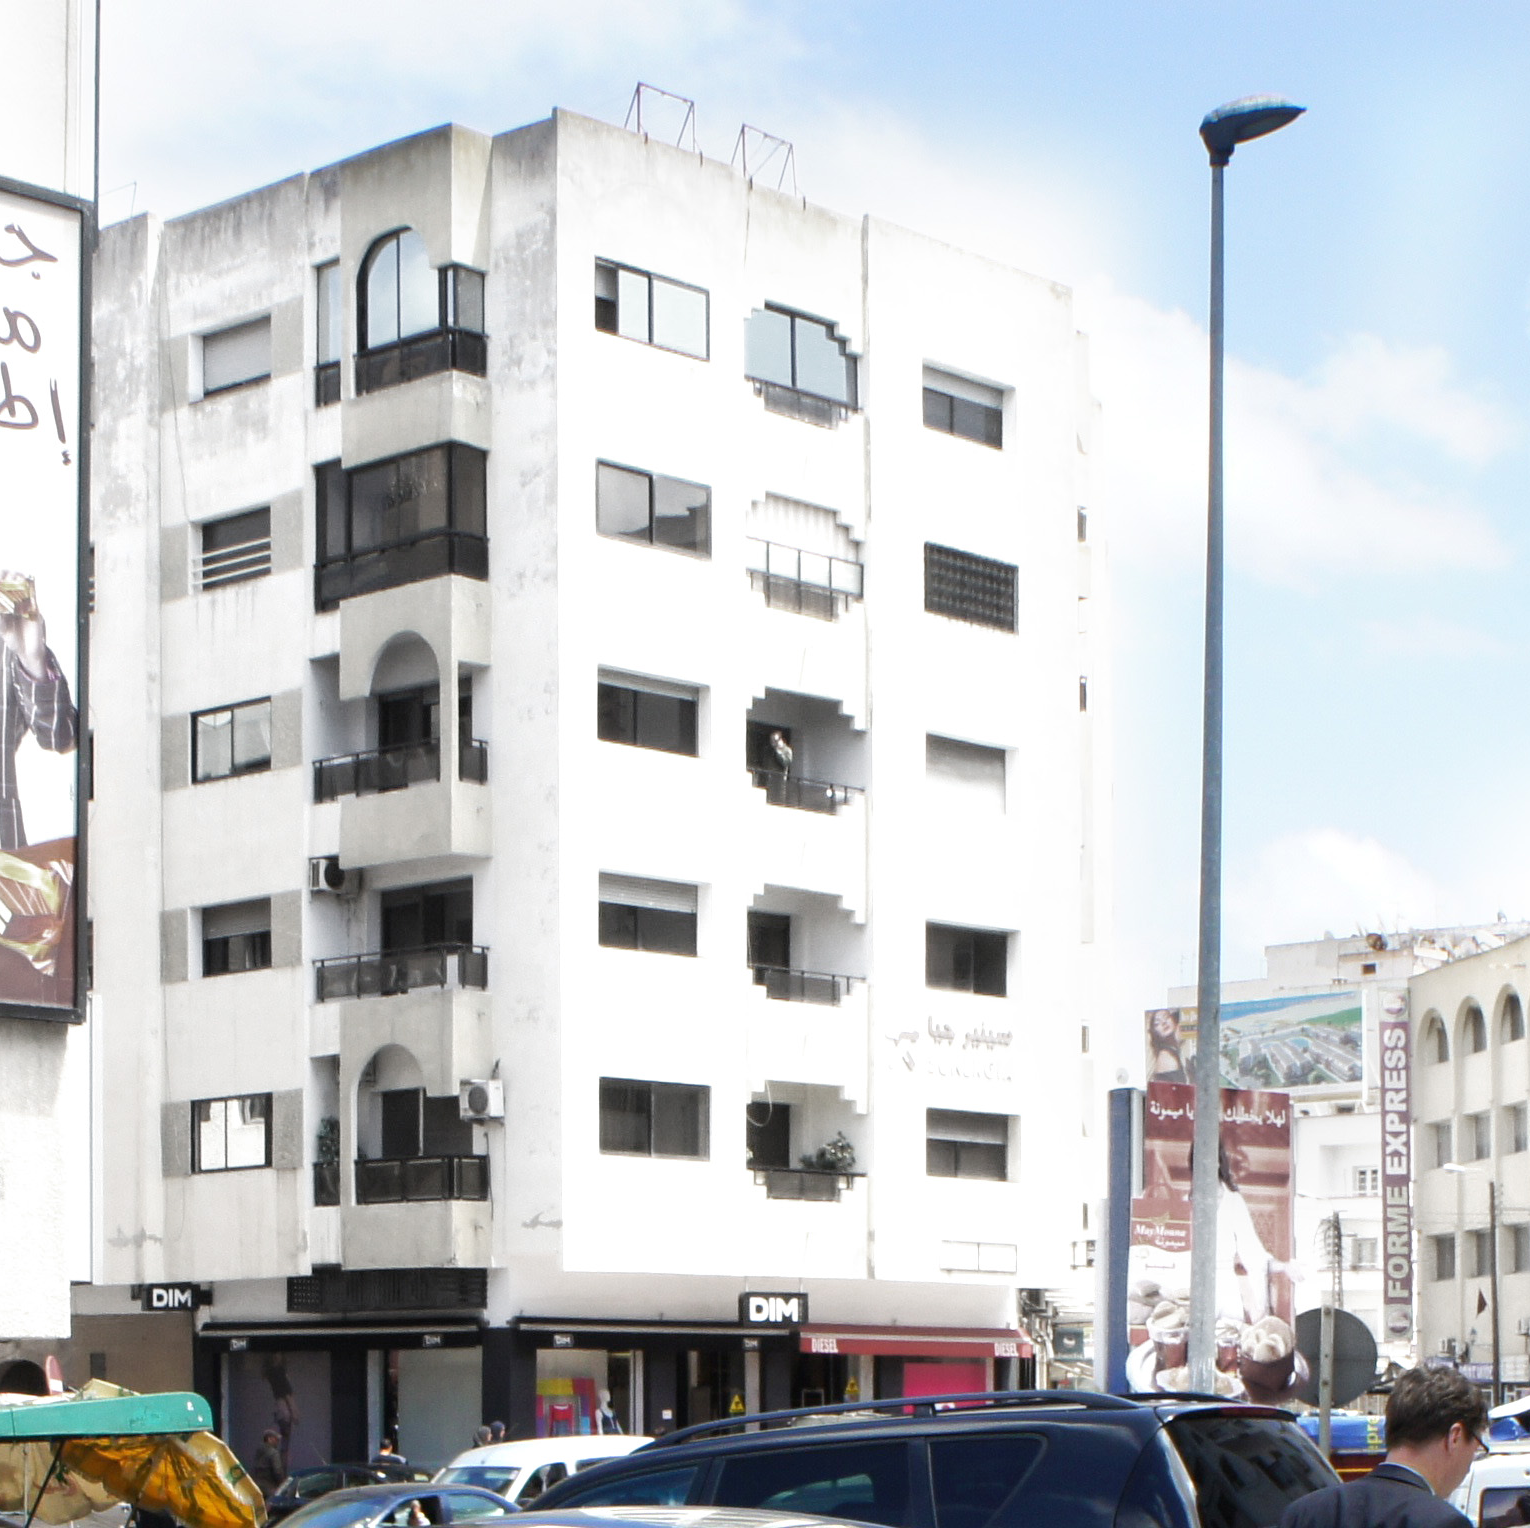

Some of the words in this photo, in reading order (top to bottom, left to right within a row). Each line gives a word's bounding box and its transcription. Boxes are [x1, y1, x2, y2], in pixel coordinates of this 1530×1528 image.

[1383, 1027, 1408, 1176] EXPRESS
[1387, 1185, 1410, 1300] FORME
[152, 1288, 193, 1308] DIM
[748, 1297, 799, 1322] DIM
[811, 1337, 839, 1354] DIESEL
[994, 1342, 1019, 1357] DIESEL
